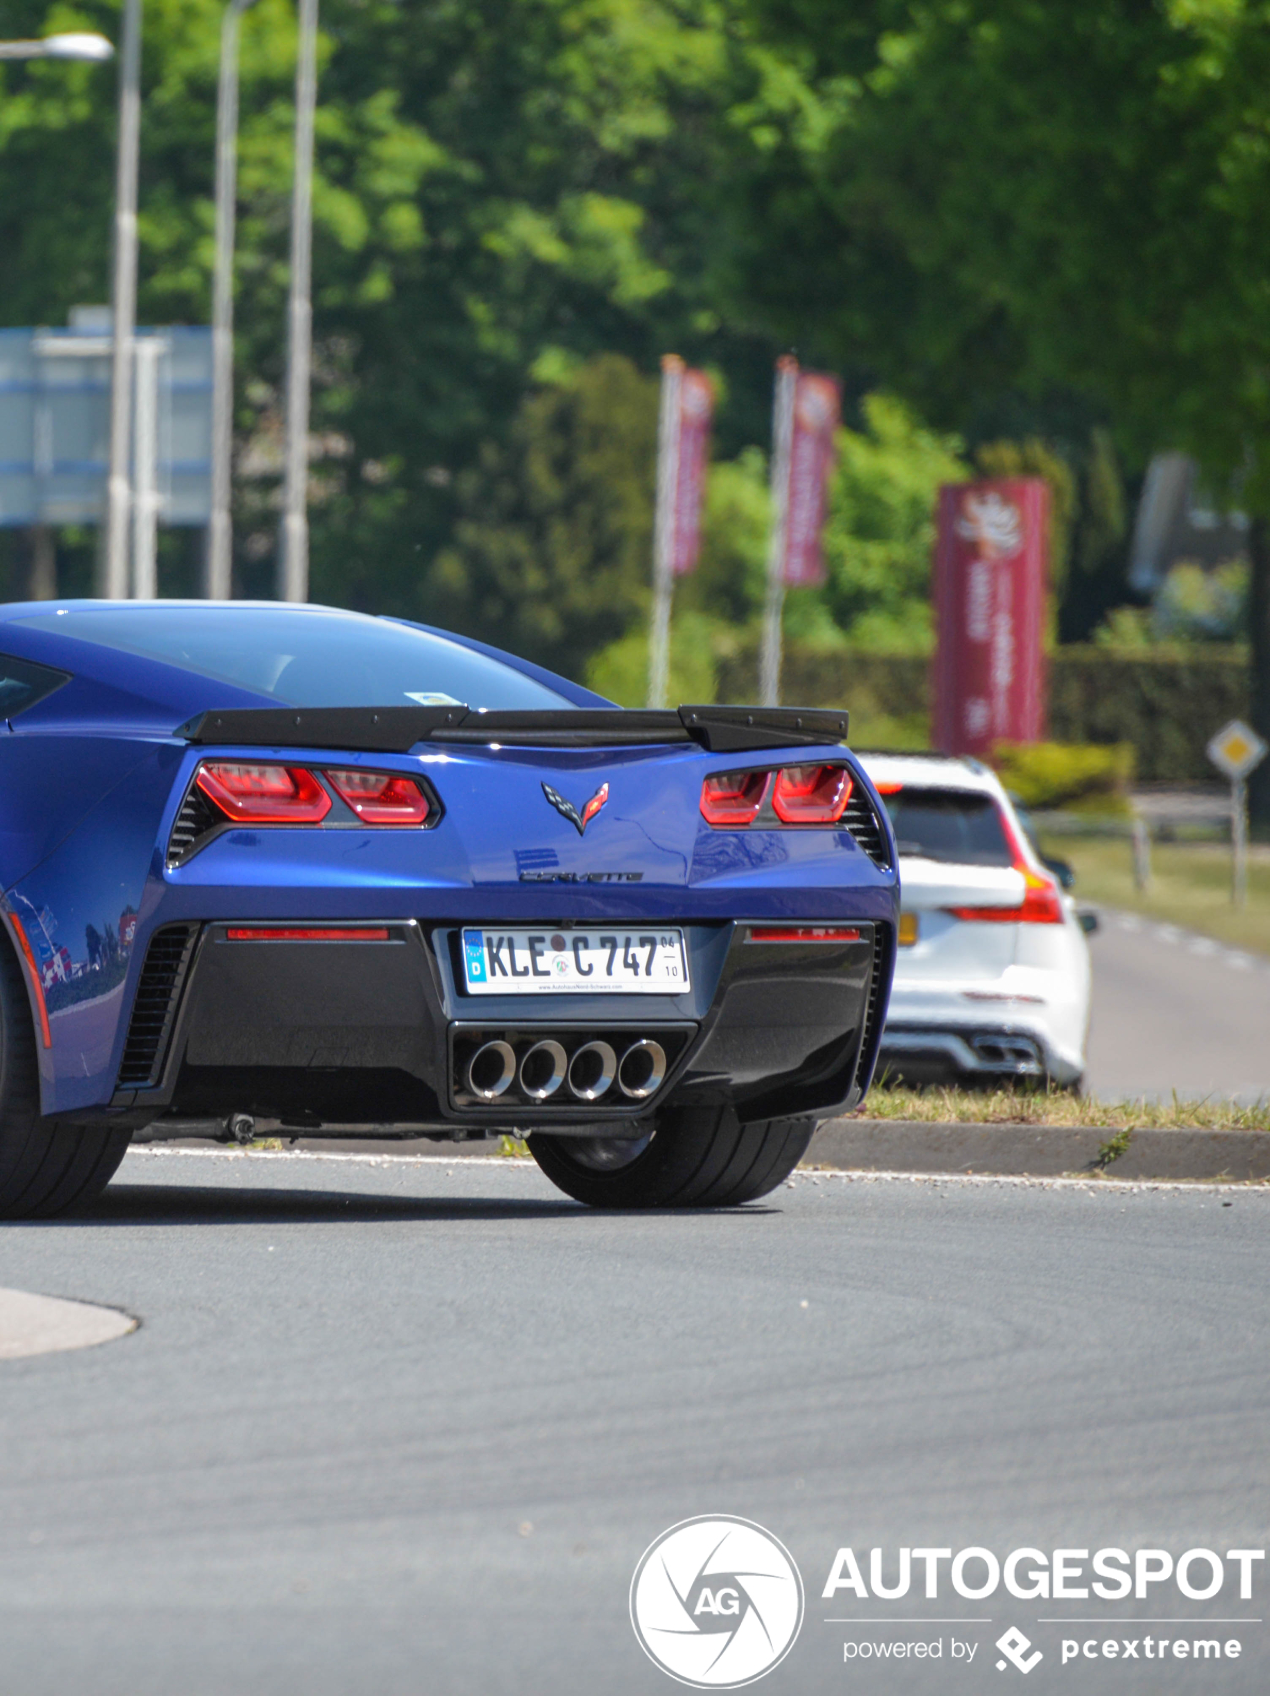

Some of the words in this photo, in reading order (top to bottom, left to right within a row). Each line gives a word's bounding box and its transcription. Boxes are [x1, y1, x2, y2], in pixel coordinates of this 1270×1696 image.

[486, 936, 551, 977] KLE
[572, 936, 594, 977] C
[599, 936, 658, 977] 747
[471, 962, 481, 975] D
[665, 966, 678, 977] 10
